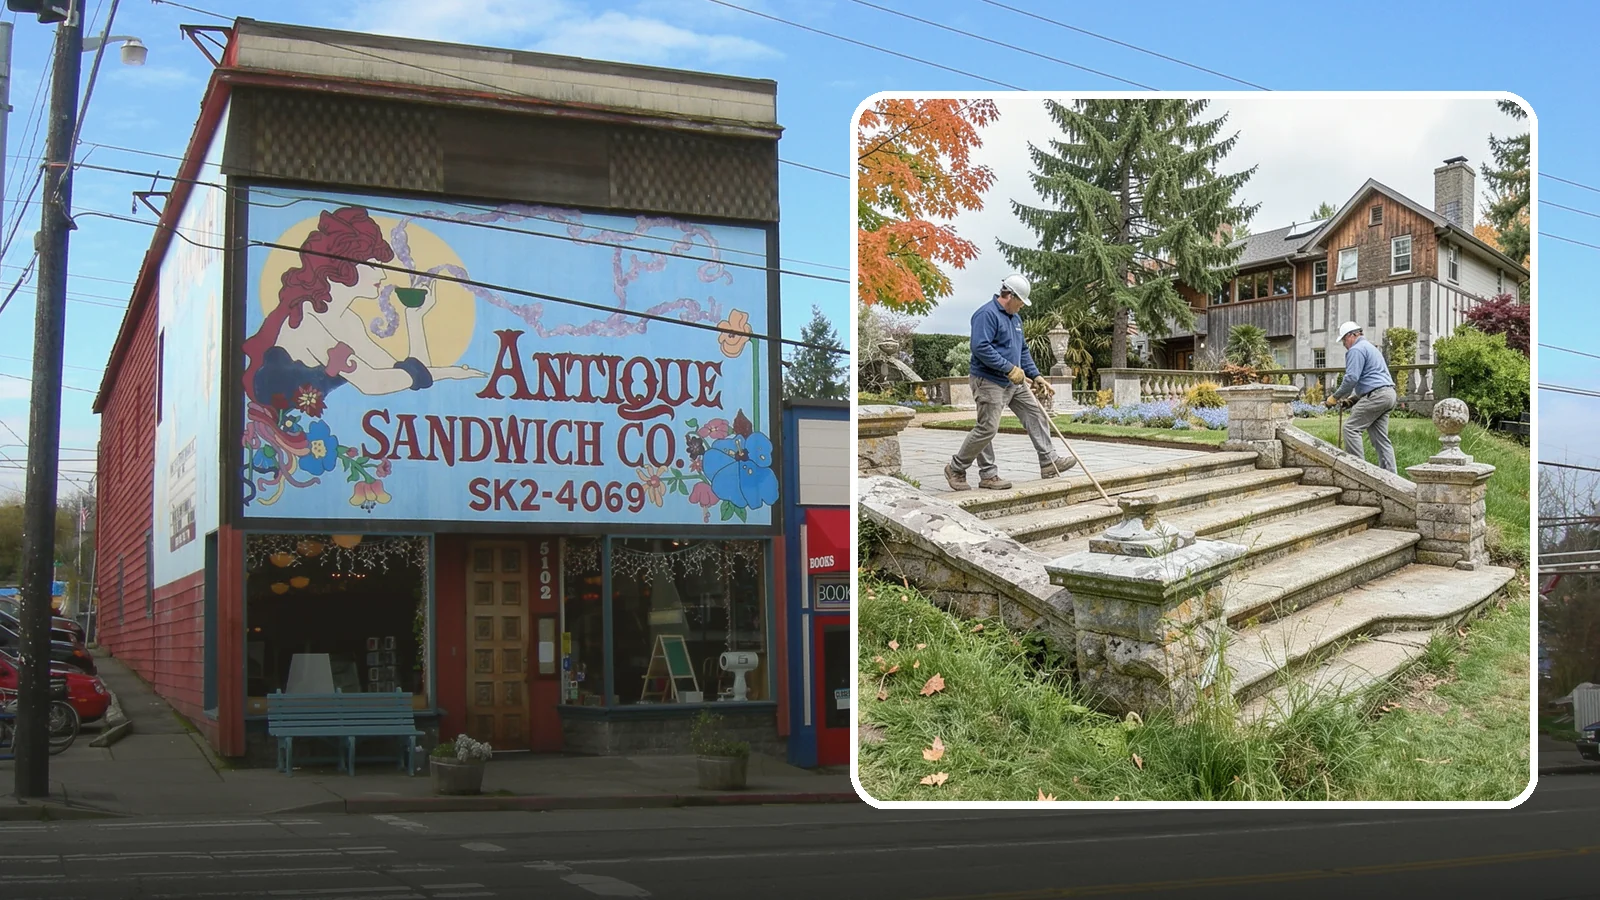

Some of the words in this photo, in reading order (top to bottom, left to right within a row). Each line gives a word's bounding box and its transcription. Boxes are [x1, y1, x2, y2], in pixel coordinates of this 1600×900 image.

[476, 329, 724, 421] ANTIQUE
[361, 408, 604, 467] SANDWICH
[617, 423, 685, 469] CO.
[468, 477, 646, 513] SK2-4069
[539, 542, 552, 600] 5102
[809, 555, 835, 569] BOOKS
